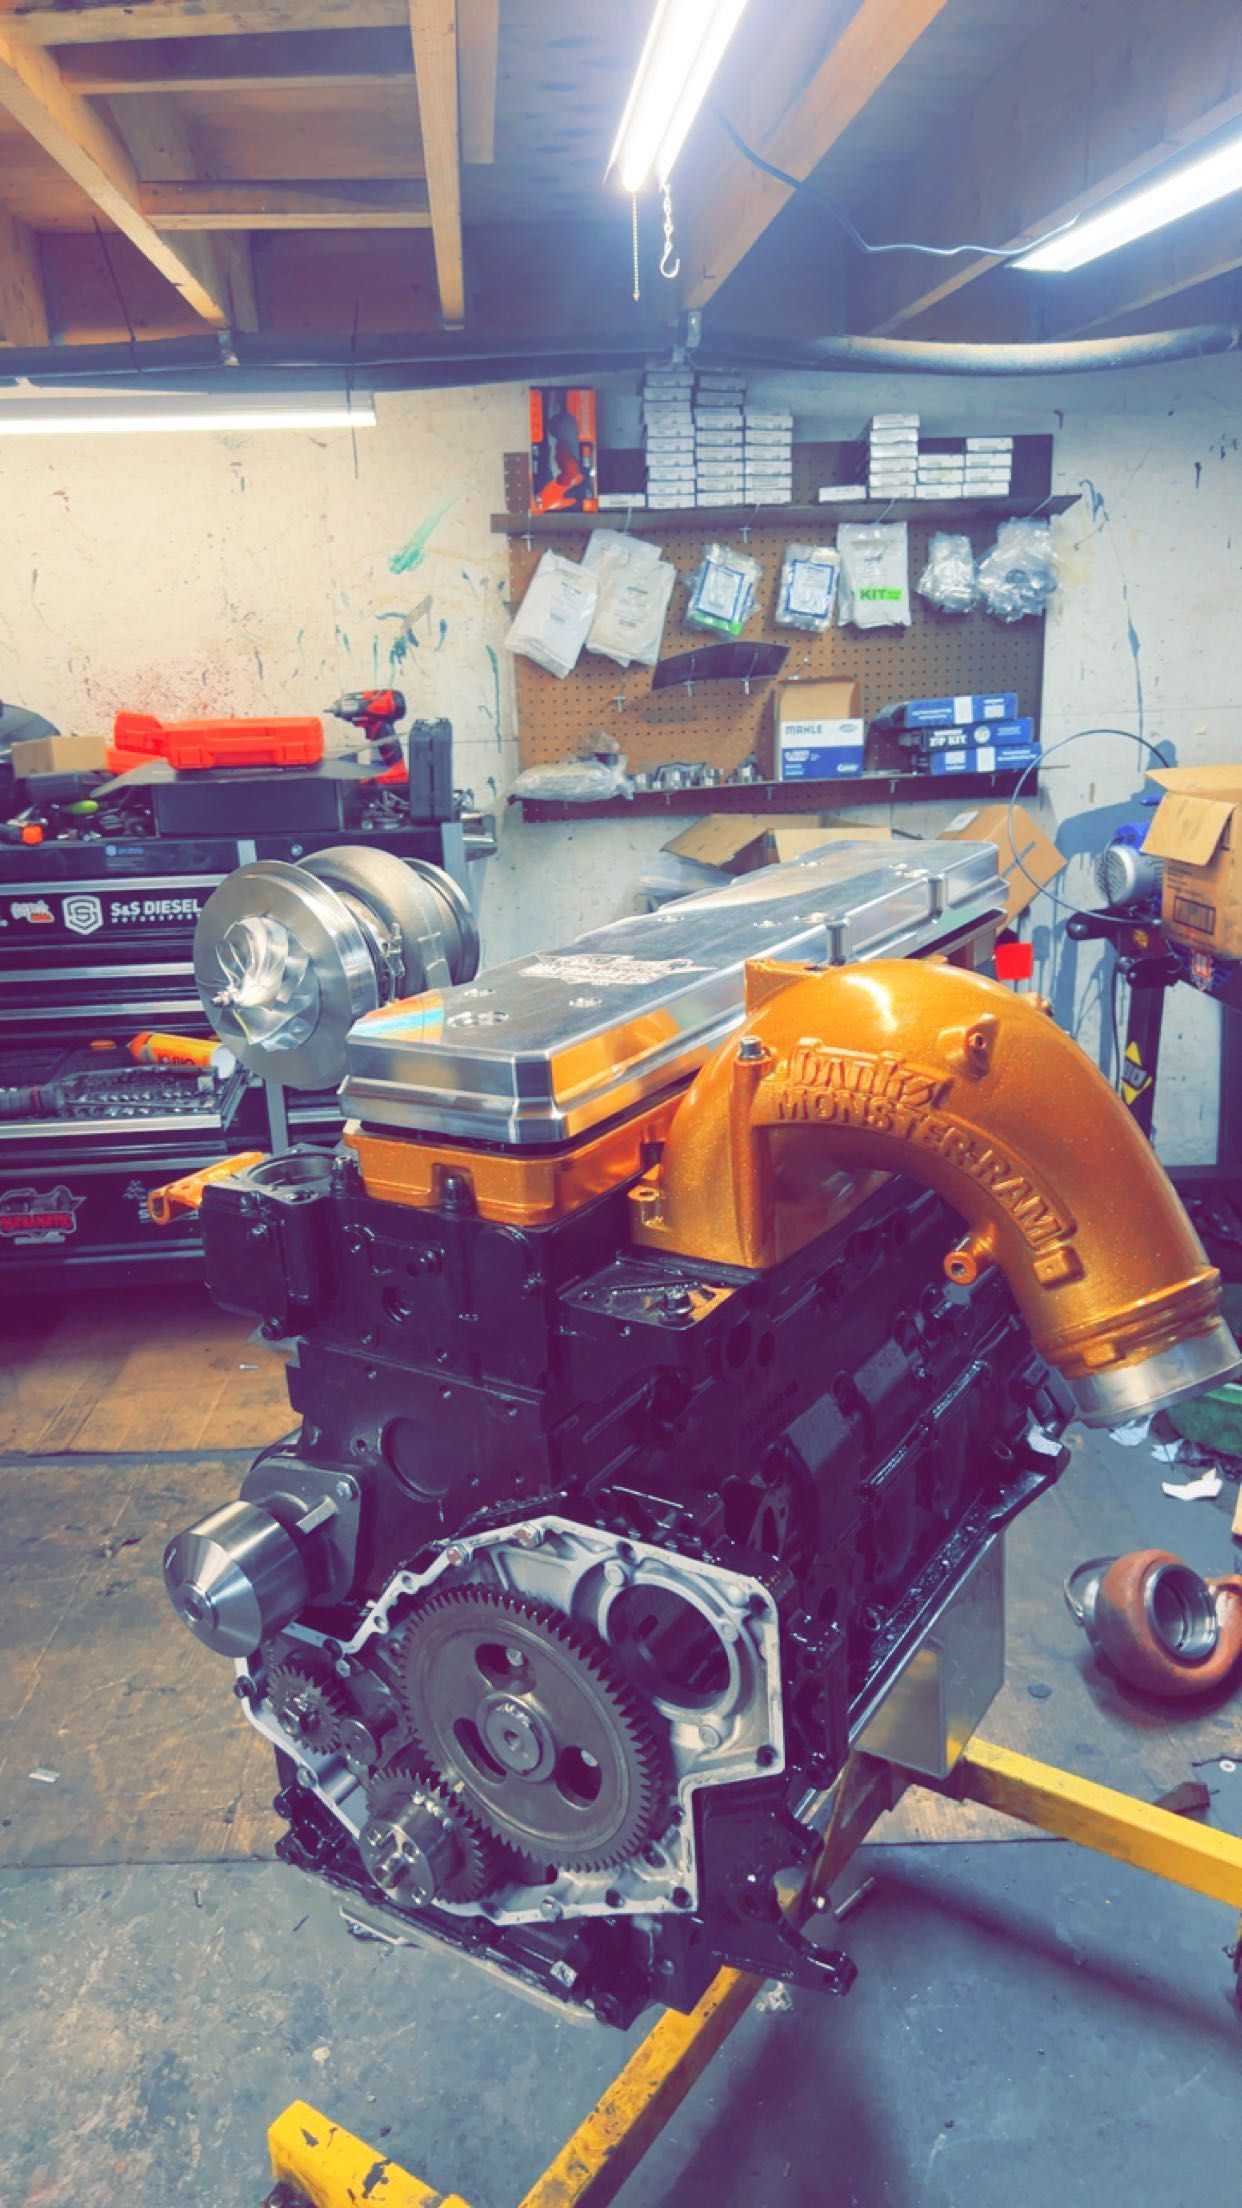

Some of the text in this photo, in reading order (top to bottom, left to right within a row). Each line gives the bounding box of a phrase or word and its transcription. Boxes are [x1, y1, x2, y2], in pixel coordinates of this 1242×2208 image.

[860, 588, 887, 600] KIT
[785, 724, 824, 735] MAHLE
[948, 734, 968, 746] KIT
[111, 898, 203, 917] S&S DIESEL
